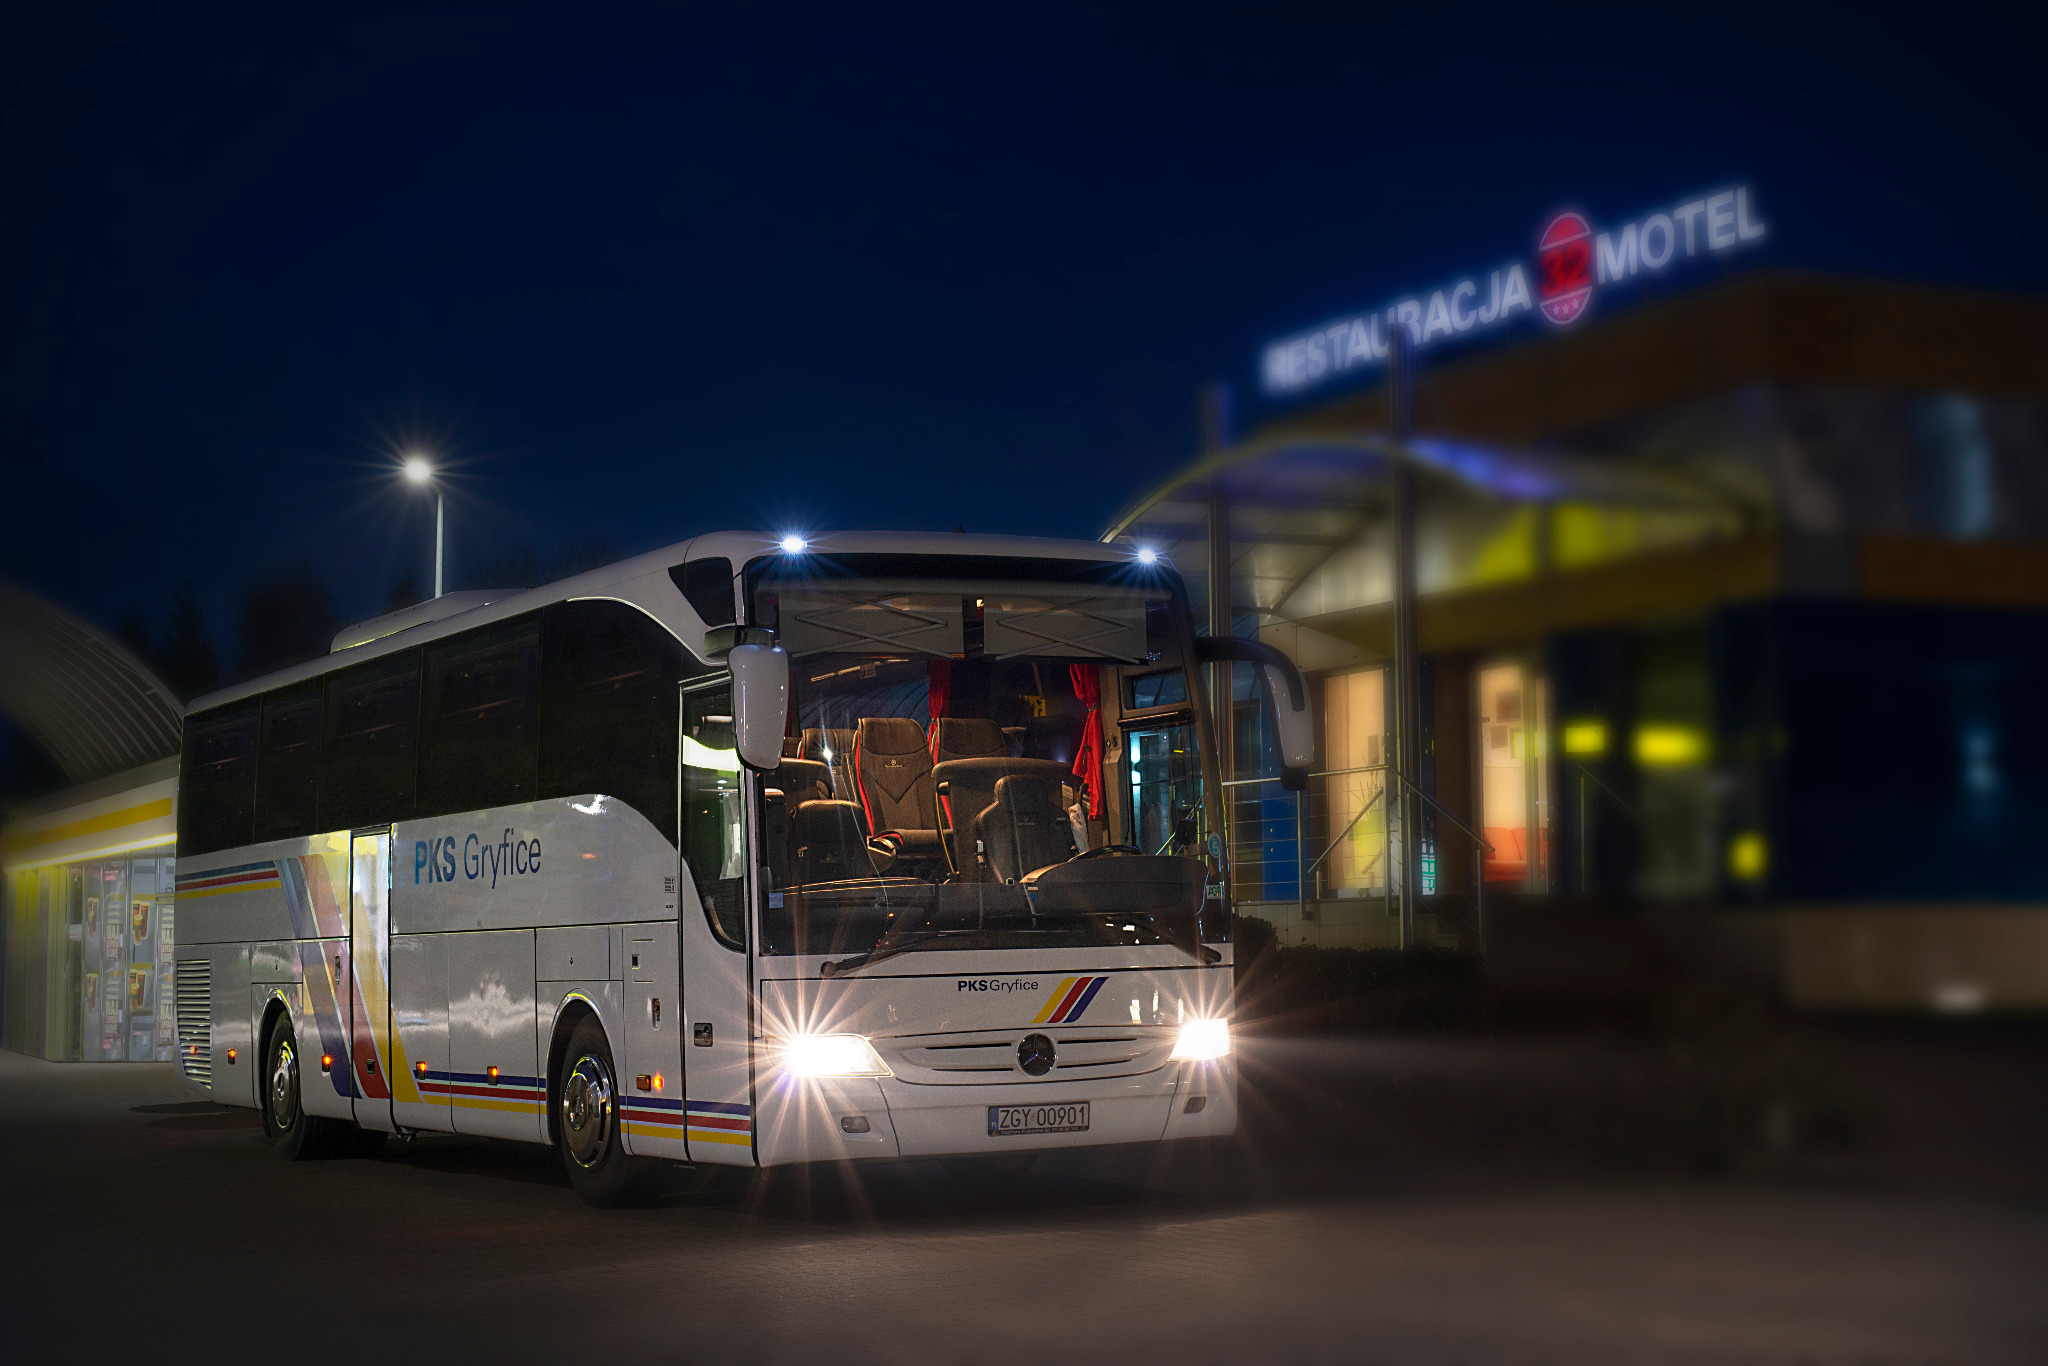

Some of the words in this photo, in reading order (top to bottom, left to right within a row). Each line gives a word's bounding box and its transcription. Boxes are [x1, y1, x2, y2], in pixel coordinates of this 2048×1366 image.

[1266, 263, 1533, 391] RESTAURACJA
[1541, 239, 1591, 297] 32
[1596, 186, 1765, 285] MOTEL
[415, 836, 456, 885] PKS
[464, 828, 541, 890] Gryfice
[957, 979, 988, 992] PKS
[989, 978, 1039, 994] Gryfice
[1000, 1109, 1031, 1128] ZGY
[1037, 1106, 1085, 1126] 00901
